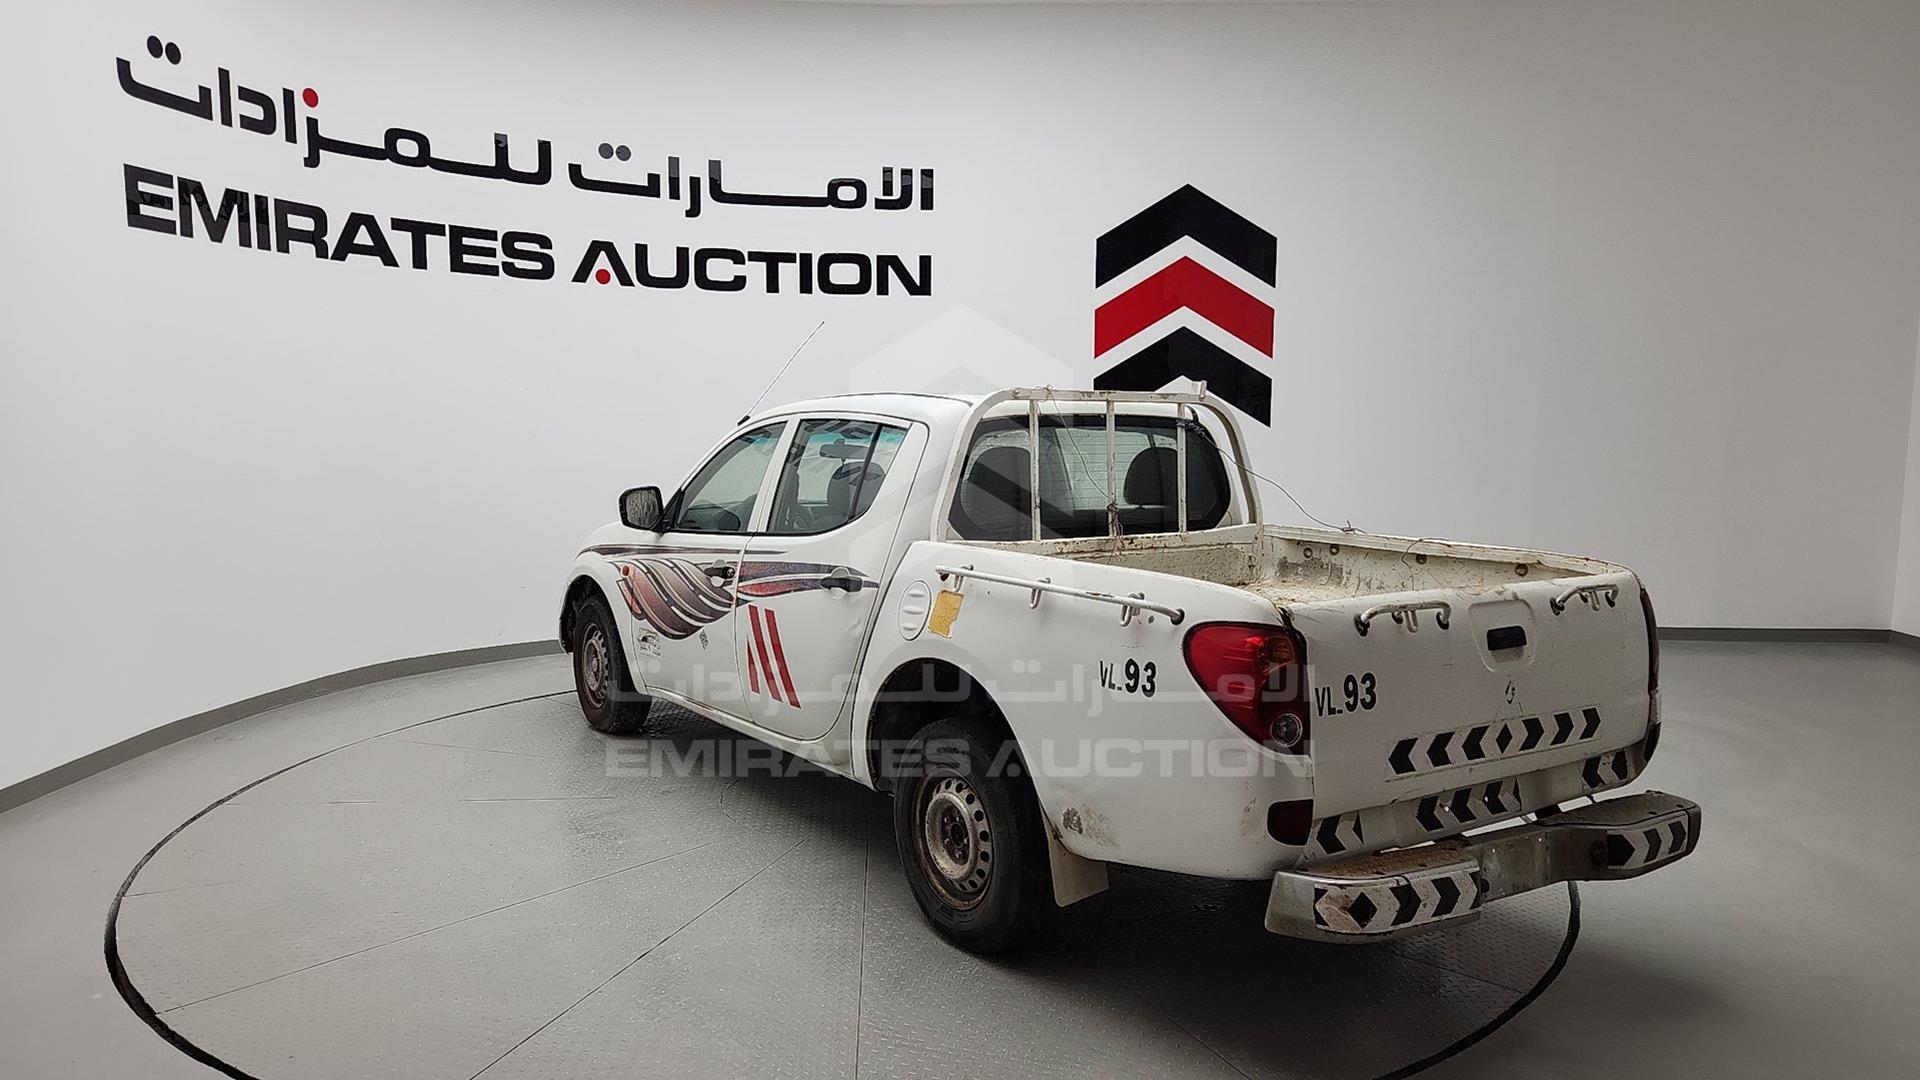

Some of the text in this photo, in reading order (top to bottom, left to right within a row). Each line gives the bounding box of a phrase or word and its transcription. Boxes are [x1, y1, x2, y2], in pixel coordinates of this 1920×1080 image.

[116, 36, 551, 185] للمزادات
[124, 164, 931, 296] EMIRATES AUCTION
